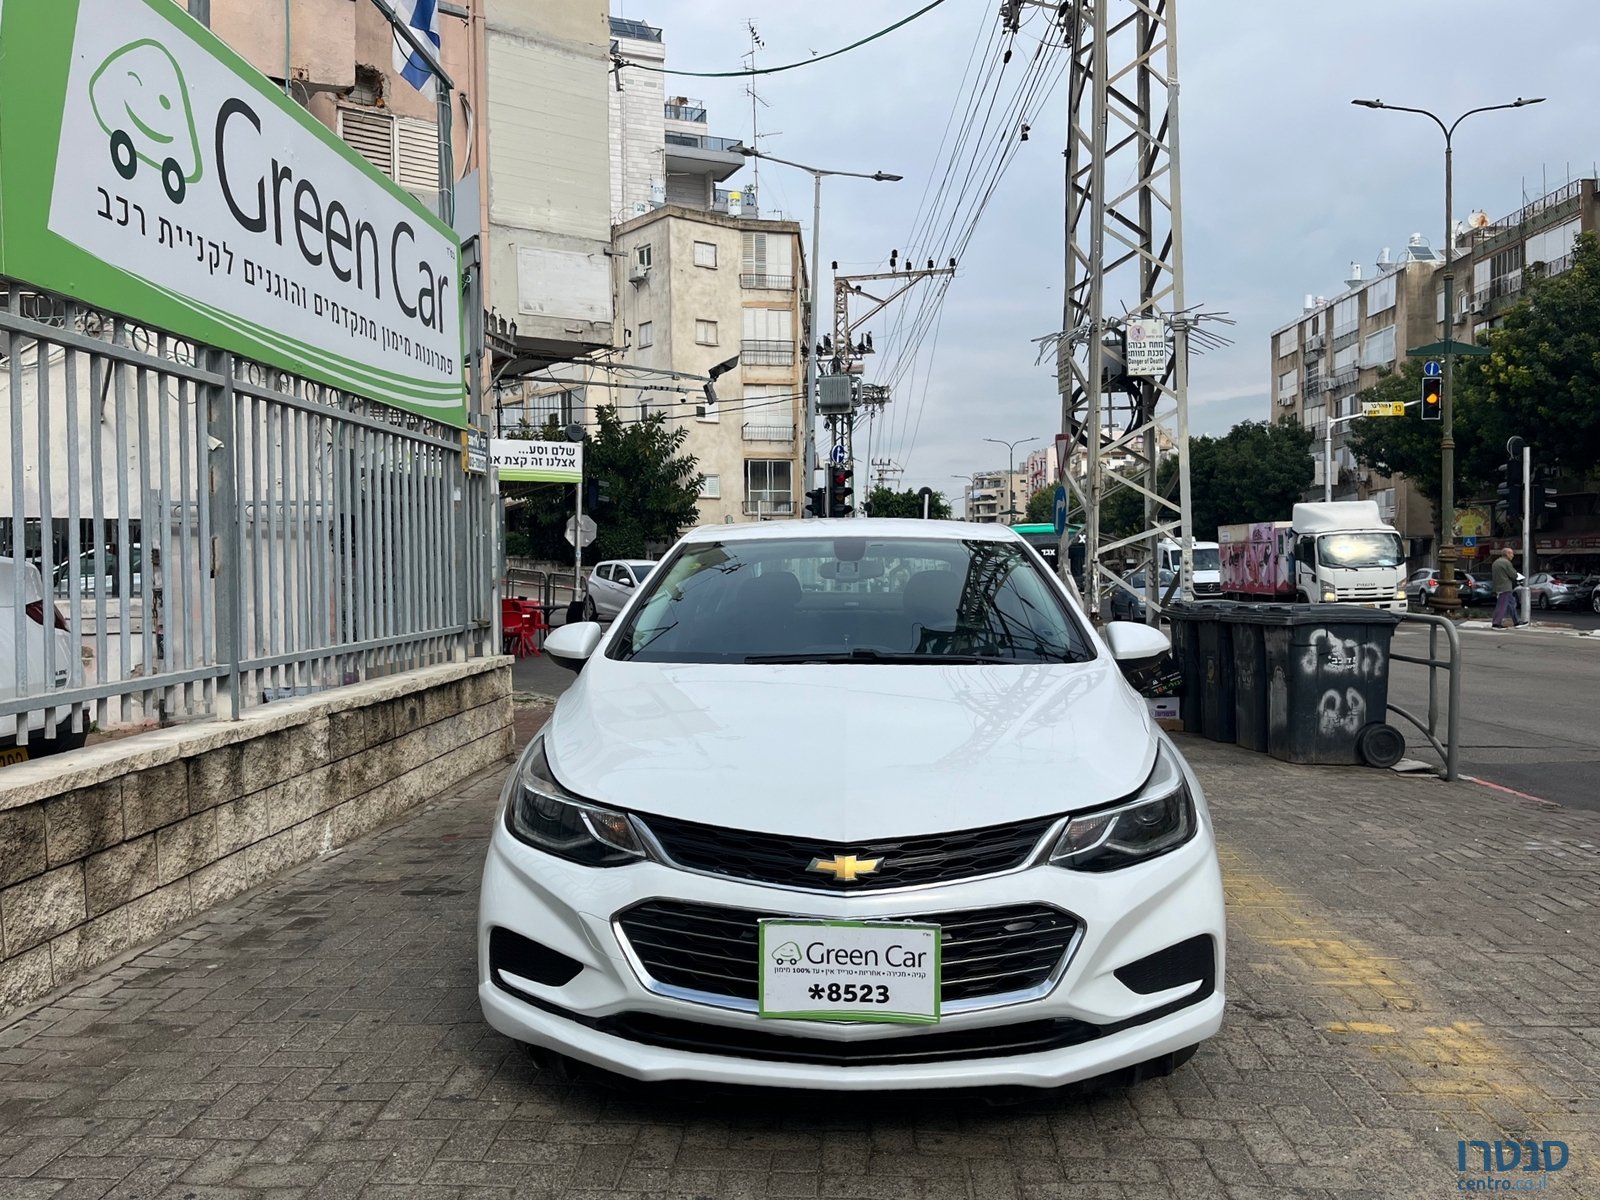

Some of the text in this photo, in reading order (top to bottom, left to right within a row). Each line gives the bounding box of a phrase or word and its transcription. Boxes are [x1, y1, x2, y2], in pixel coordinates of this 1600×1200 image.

[215, 97, 448, 334] Green Car
[97, 186, 453, 375] פתרונות מימון מתקדמים והוגנים לקניית רכב
[1394, 404, 1402, 412] 13
[518, 445, 575, 456] שלם וסע...
[504, 456, 528, 468] קצת
[531, 457, 543, 466] זה
[546, 457, 576, 467] אצלנו
[806, 941, 927, 968] Green Car
[825, 968, 835, 976] אין
[911, 971, 927, 979] קניה
